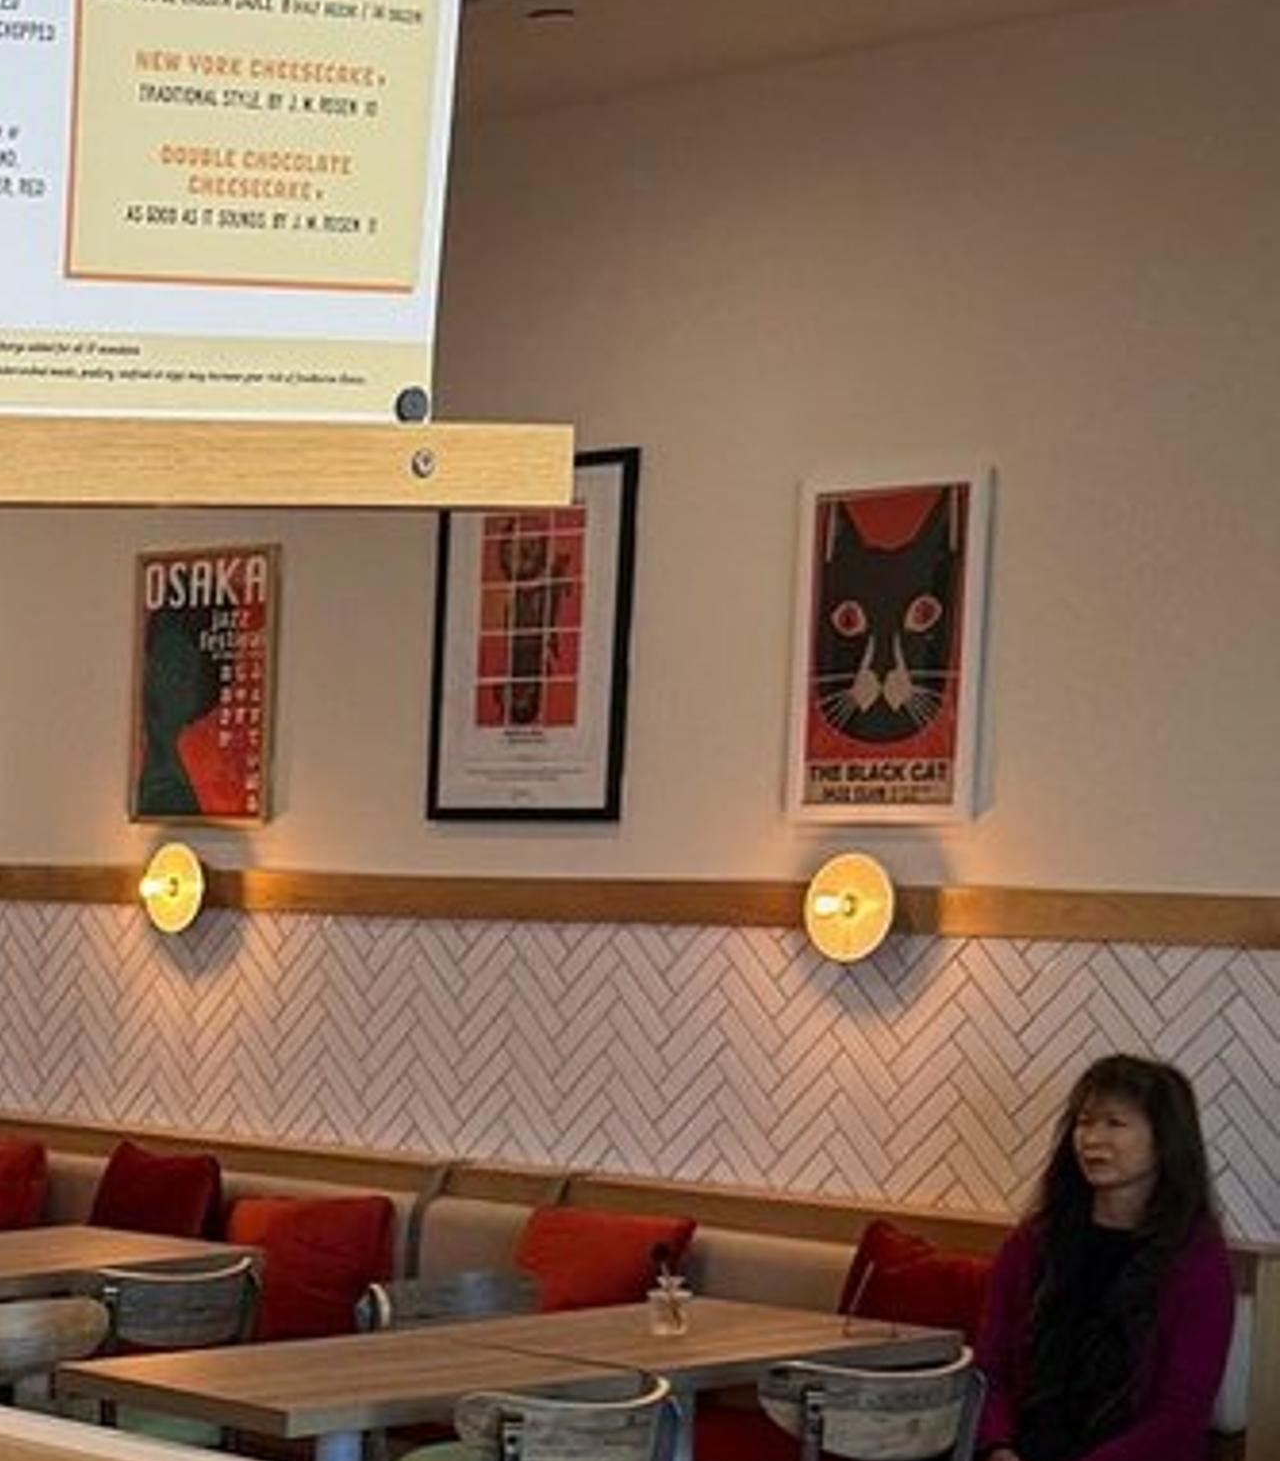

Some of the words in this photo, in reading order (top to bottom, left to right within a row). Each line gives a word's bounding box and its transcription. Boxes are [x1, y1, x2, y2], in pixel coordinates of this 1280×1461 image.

[145, 555, 268, 610] OSAKA
[810, 765, 842, 782] THE
[846, 764, 904, 782] BLACK
[909, 762, 947, 782] CAT
